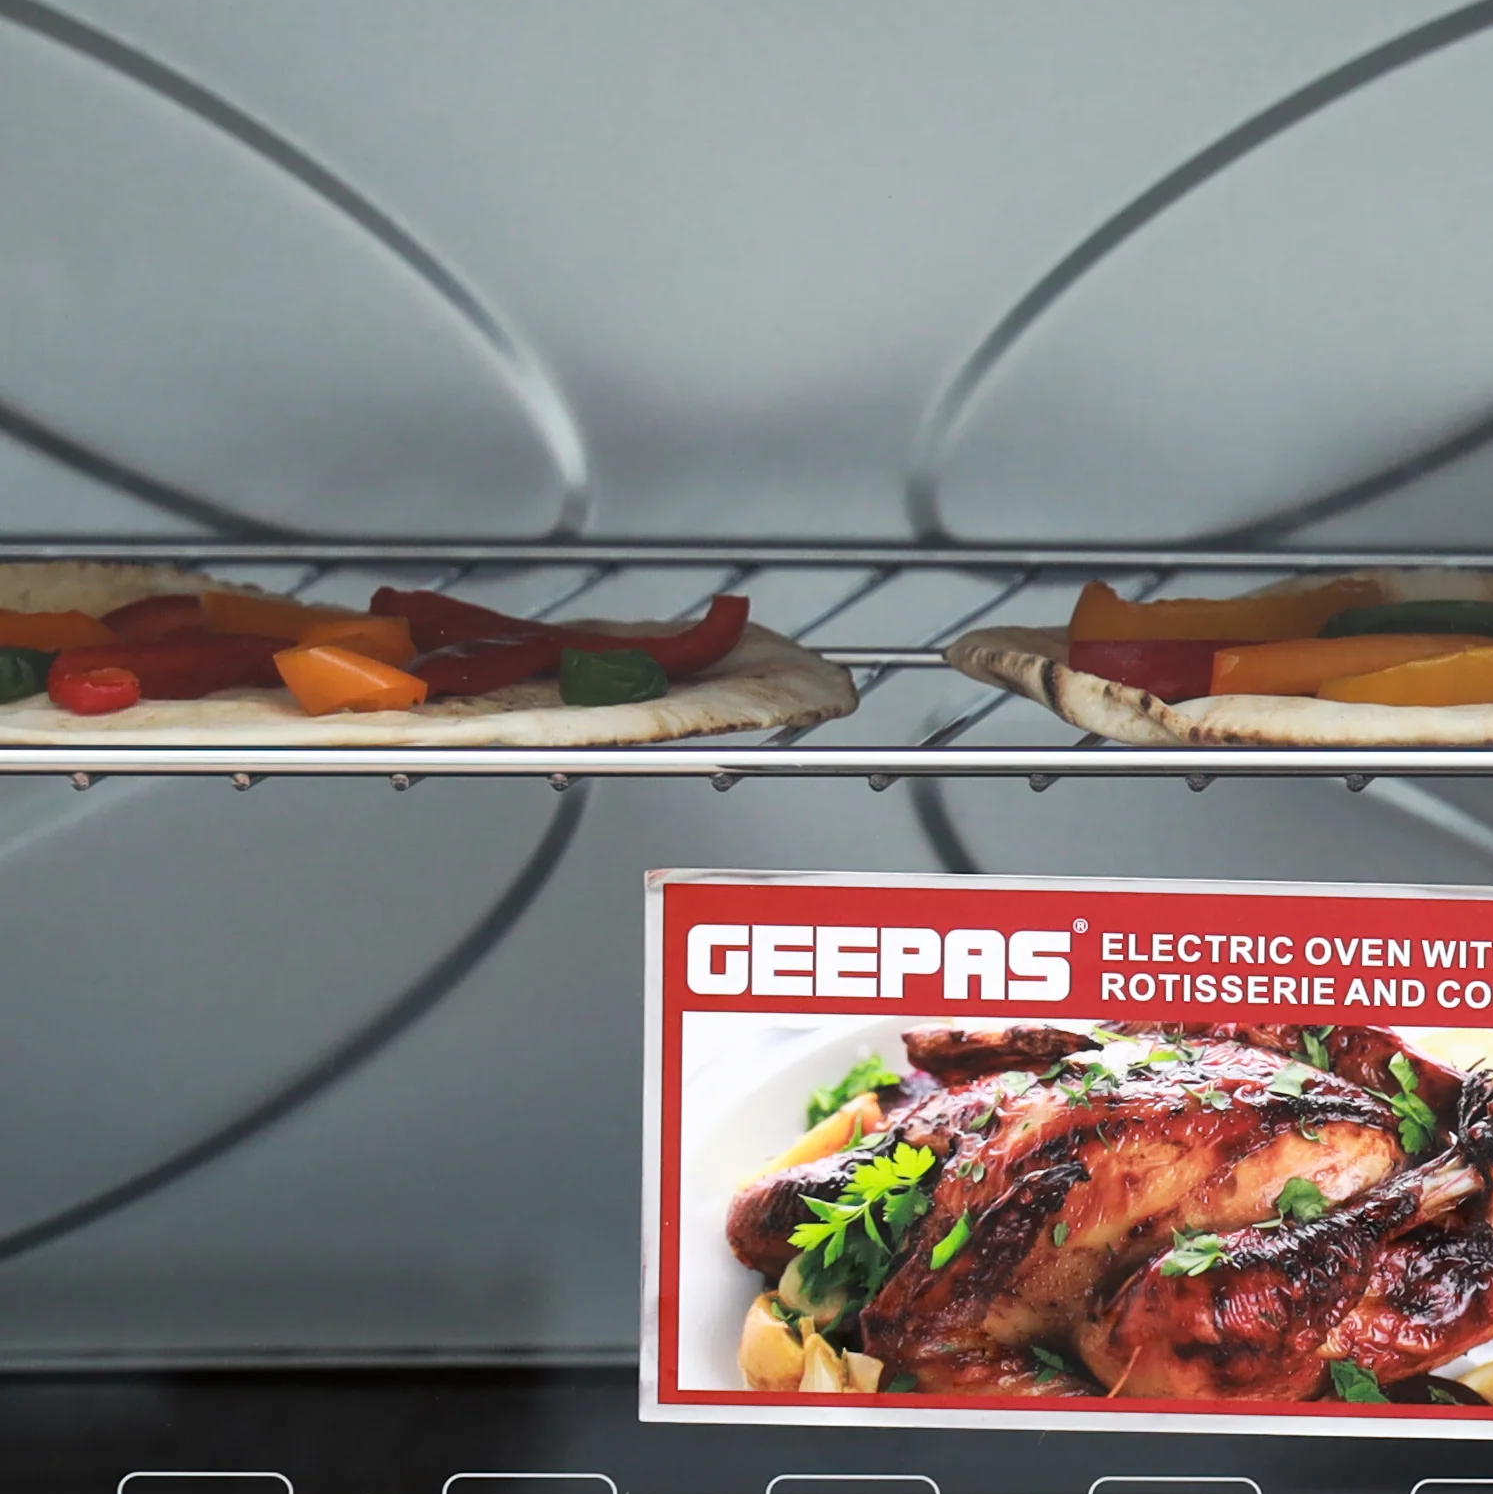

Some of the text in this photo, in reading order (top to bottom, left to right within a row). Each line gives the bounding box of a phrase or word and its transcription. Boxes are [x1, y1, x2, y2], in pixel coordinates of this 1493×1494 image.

[1102, 932, 1294, 965] ELECTRIC
[1305, 937, 1411, 967] OVEN
[1101, 972, 1335, 1006] ROTISSERIE
[1343, 978, 1426, 1007] AND
